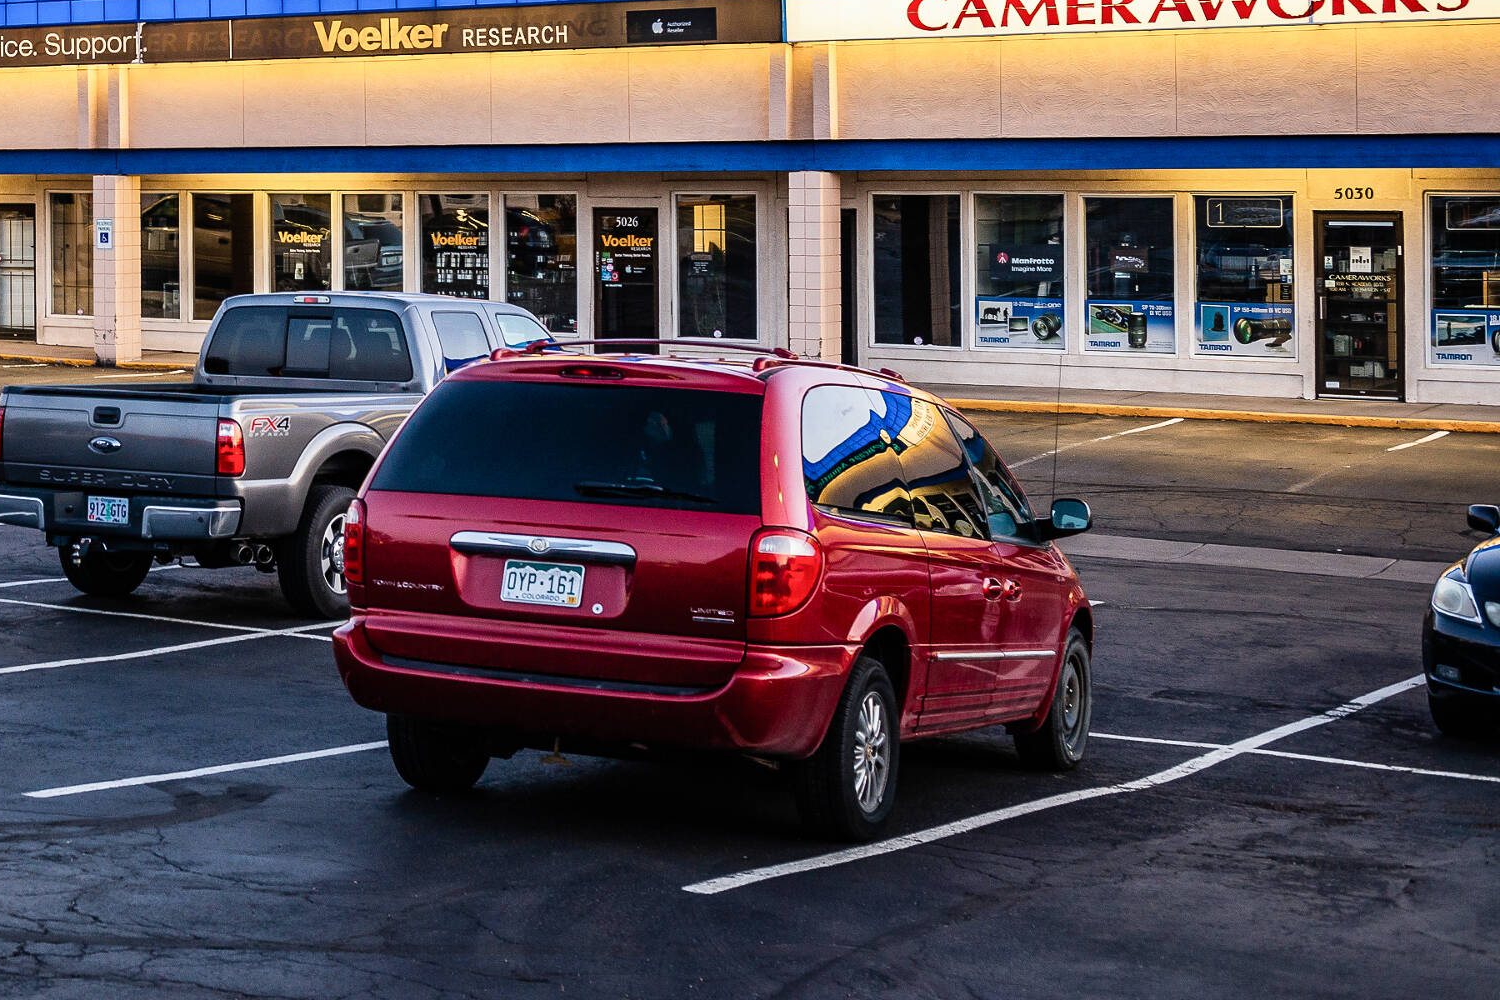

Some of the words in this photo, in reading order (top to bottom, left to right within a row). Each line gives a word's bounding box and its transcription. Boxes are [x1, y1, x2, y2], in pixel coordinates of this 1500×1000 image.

[666, 20, 692, 28] Authorized
[313, 17, 449, 52] Voelker
[462, 25, 568, 47] RESEARCH
[44, 31, 149, 60] Support.
[1334, 187, 1374, 200] 5030
[615, 216, 639, 228] 5026
[278, 231, 324, 243] Voelker
[431, 233, 479, 246] Voelker
[601, 235, 654, 247] Voelker
[1011, 257, 1055, 265] Manfrotto
[1328, 274, 1392, 282] CAMERAWORKS
[1435, 353, 1473, 361] TAMRON
[250, 416, 291, 432] FX4
[39, 469, 107, 485] SUPER
[120, 474, 177, 490] DUTY
[89, 502, 106, 517] 912
[111, 503, 127, 518] GTG
[402, 581, 445, 590] COUNTRY
[521, 592, 560, 601] COLORADO
[689, 607, 735, 616] LIMITED
